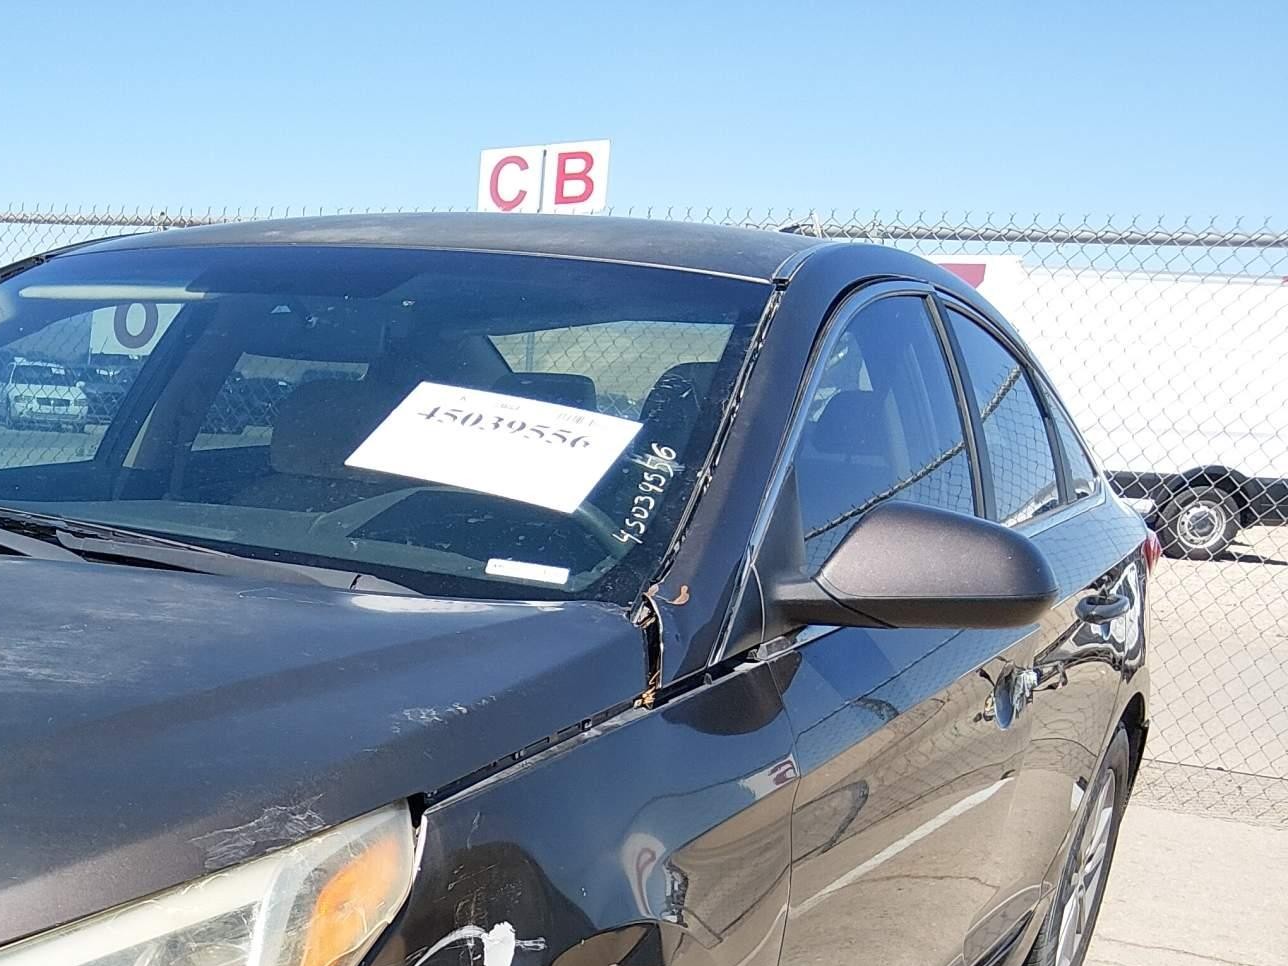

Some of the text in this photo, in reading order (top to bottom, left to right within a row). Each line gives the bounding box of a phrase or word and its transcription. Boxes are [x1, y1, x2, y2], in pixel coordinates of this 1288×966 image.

[489, 151, 595, 212] C B
[416, 404, 593, 450] 45039556
[612, 442, 678, 545] 45039556
